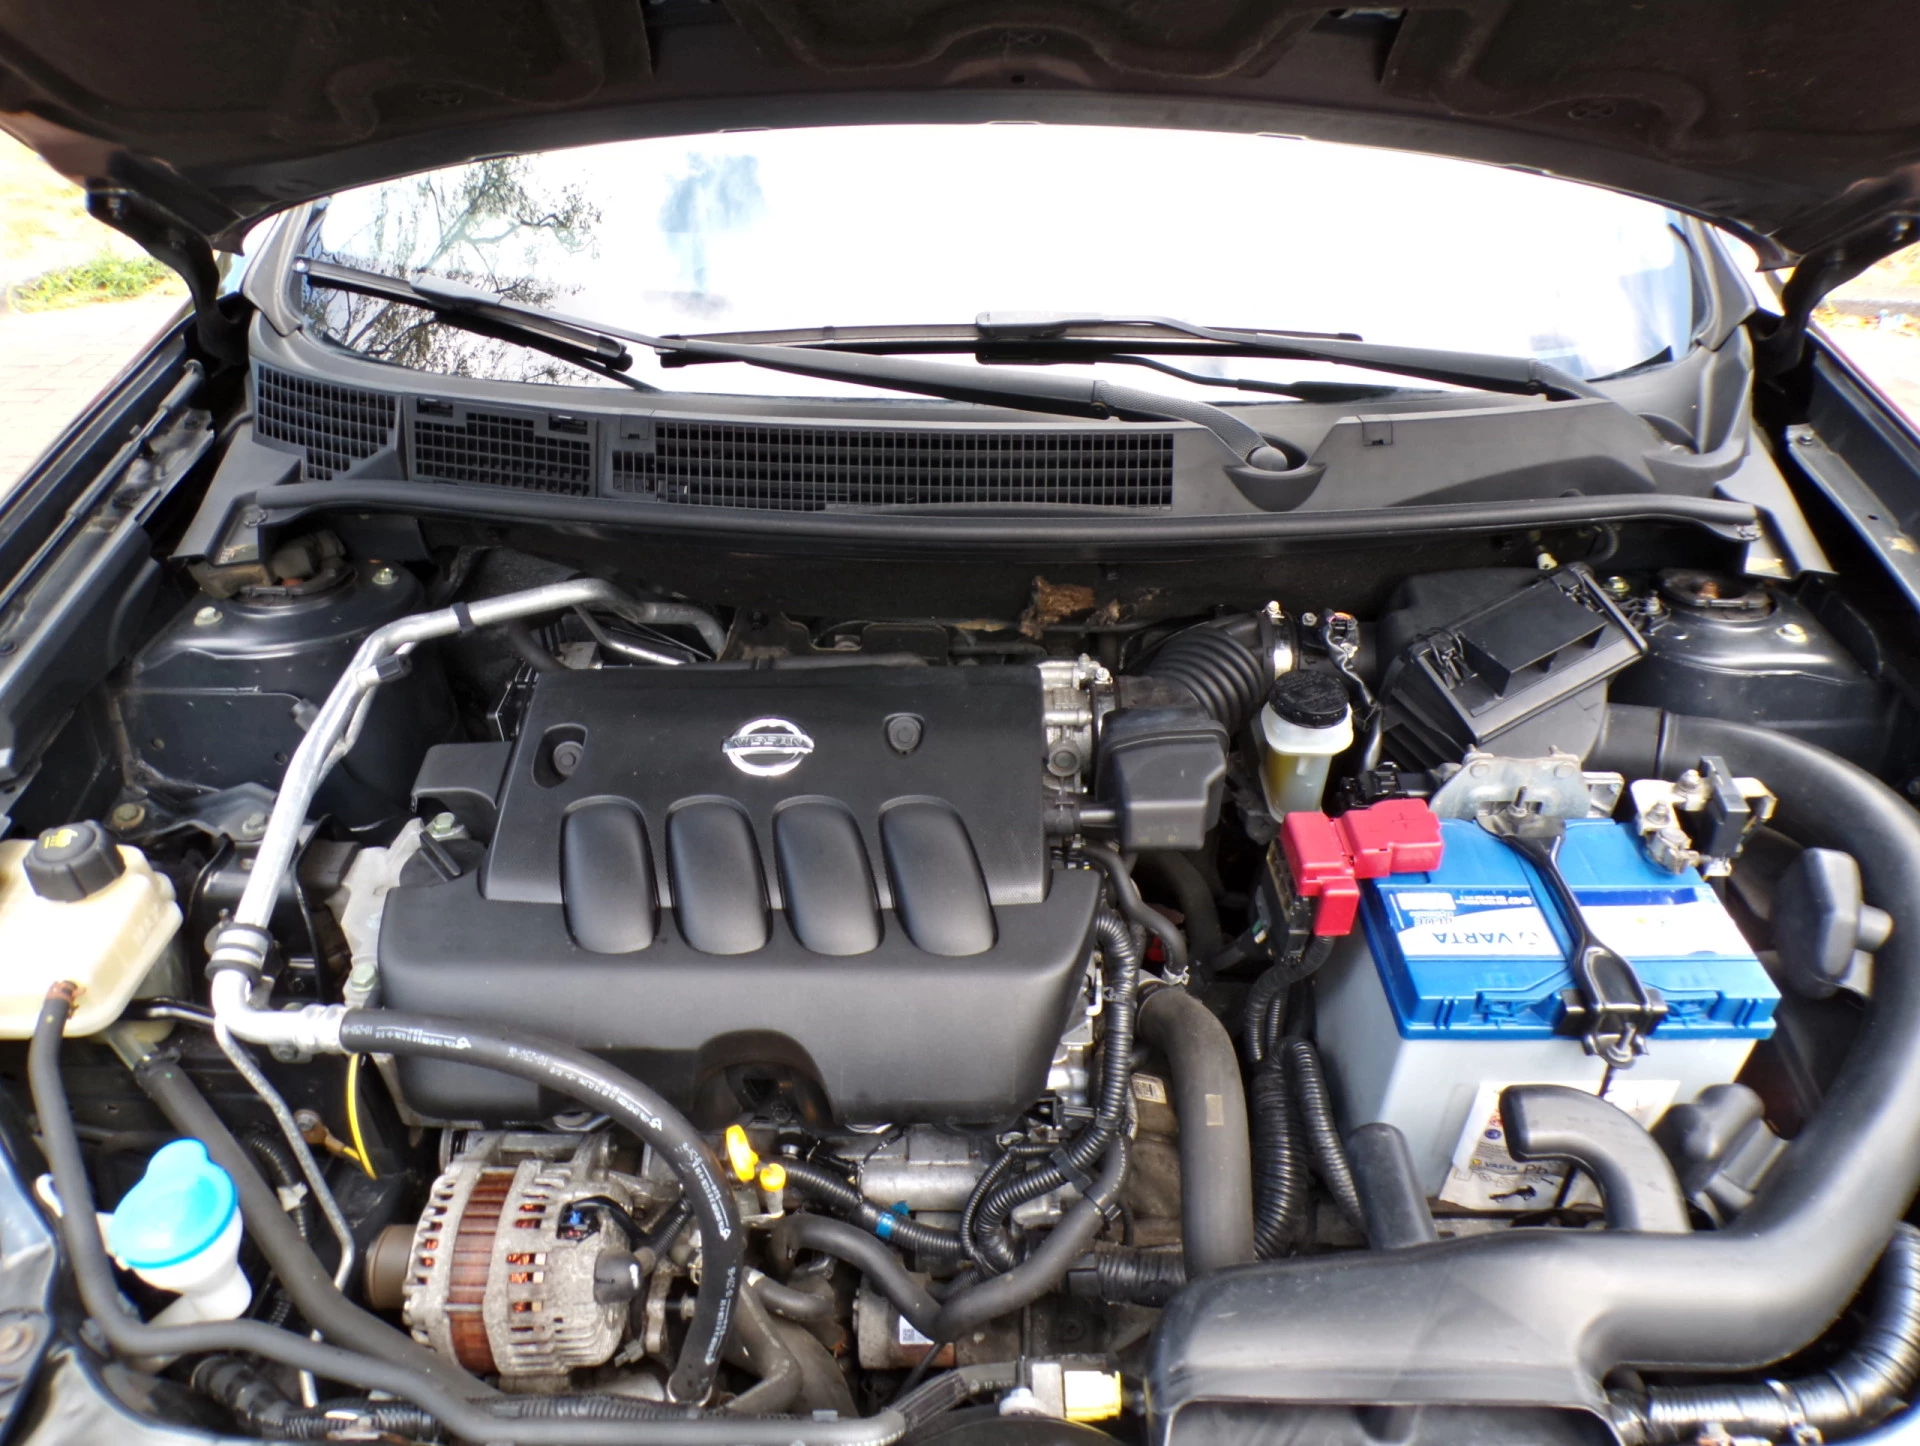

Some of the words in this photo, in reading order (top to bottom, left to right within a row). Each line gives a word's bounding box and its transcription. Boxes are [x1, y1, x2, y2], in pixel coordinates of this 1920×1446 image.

[1432, 932, 1513, 944] VARTA
[1485, 1161, 1518, 1171] VARTA
[1524, 1163, 1548, 1175] Pb
